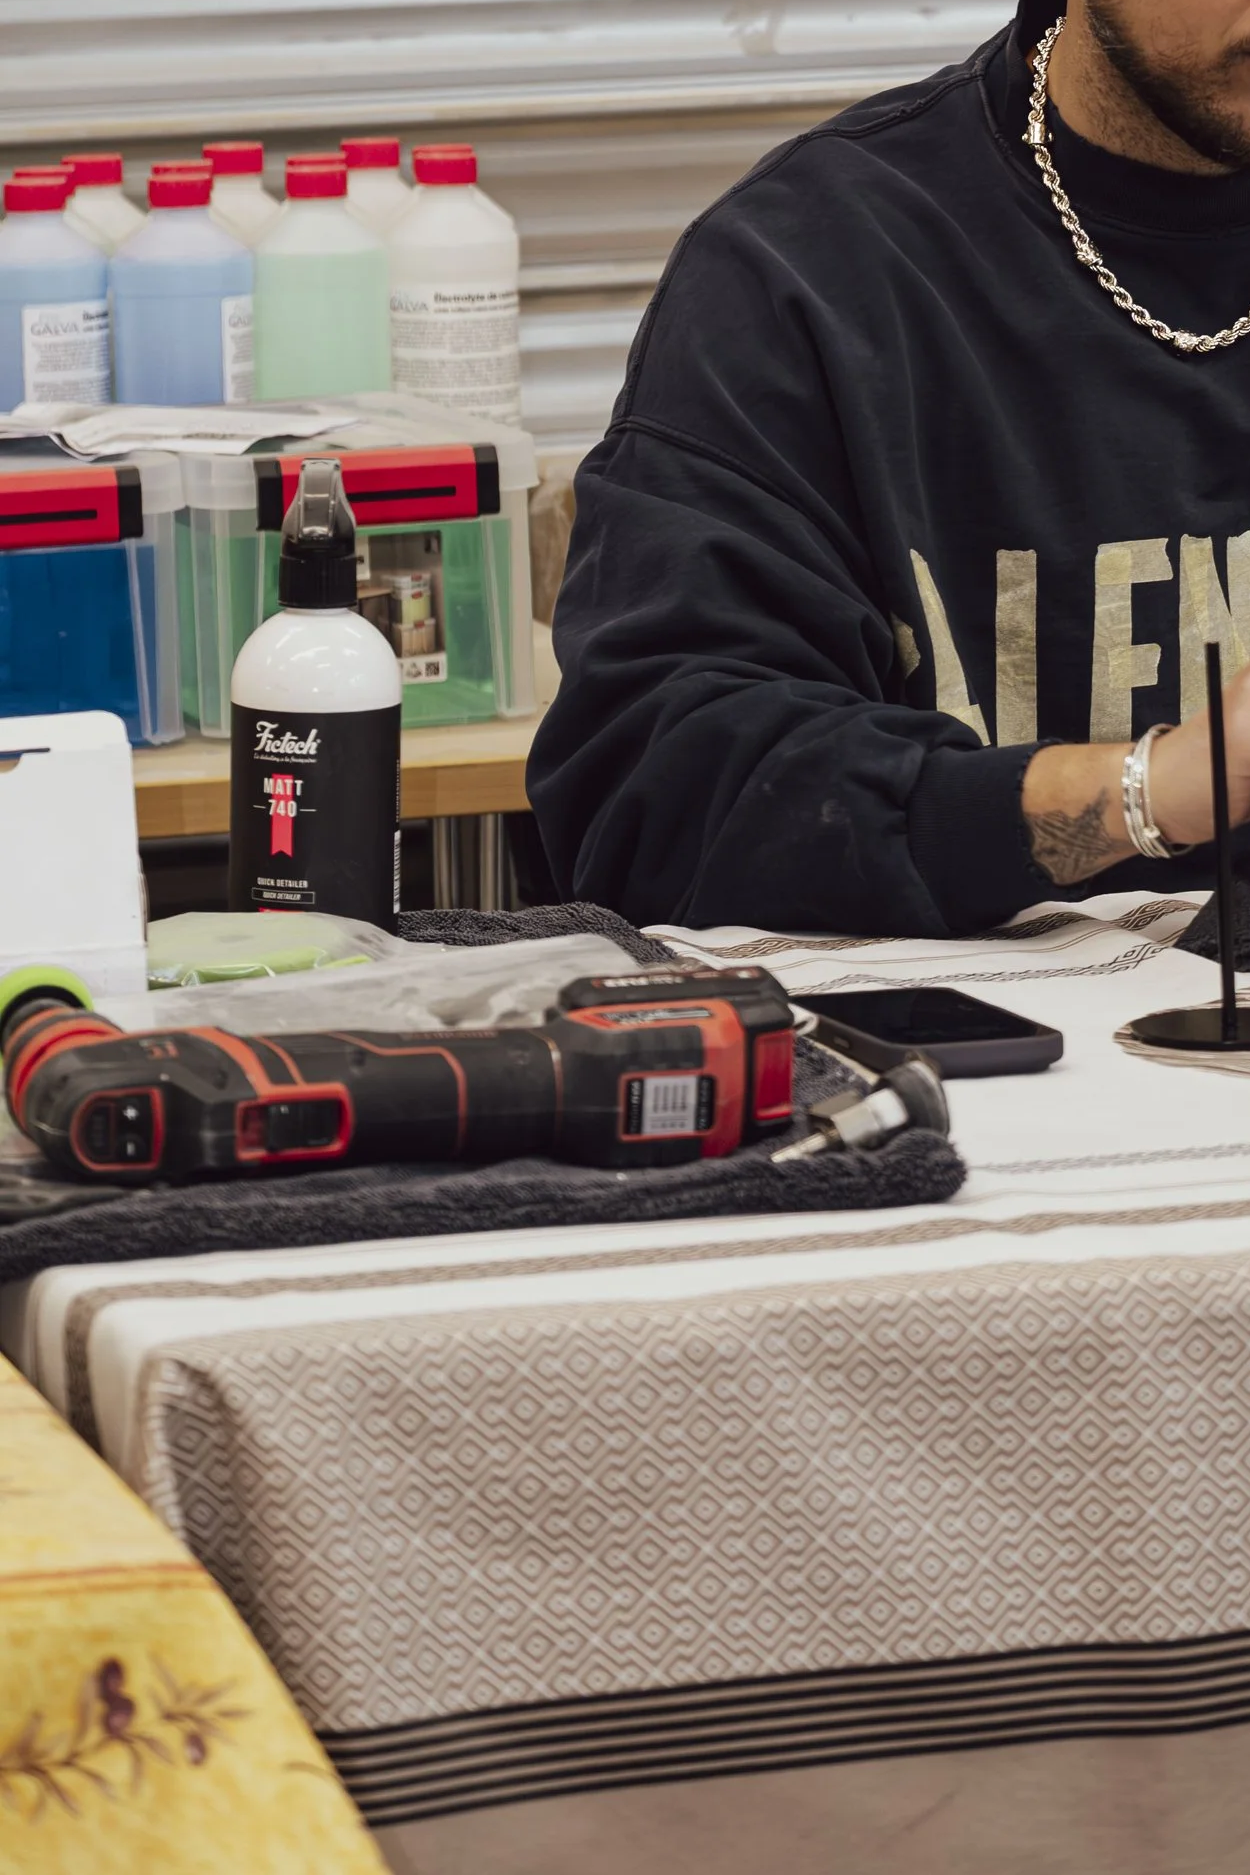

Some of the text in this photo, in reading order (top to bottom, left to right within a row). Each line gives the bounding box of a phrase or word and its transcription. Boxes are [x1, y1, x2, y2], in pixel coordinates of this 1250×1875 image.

[263, 777, 304, 796] MATT
[268, 799, 298, 818] 740
[257, 877, 309, 889] QUICK DETAILER
[276, 892, 301, 901] DETAILER
